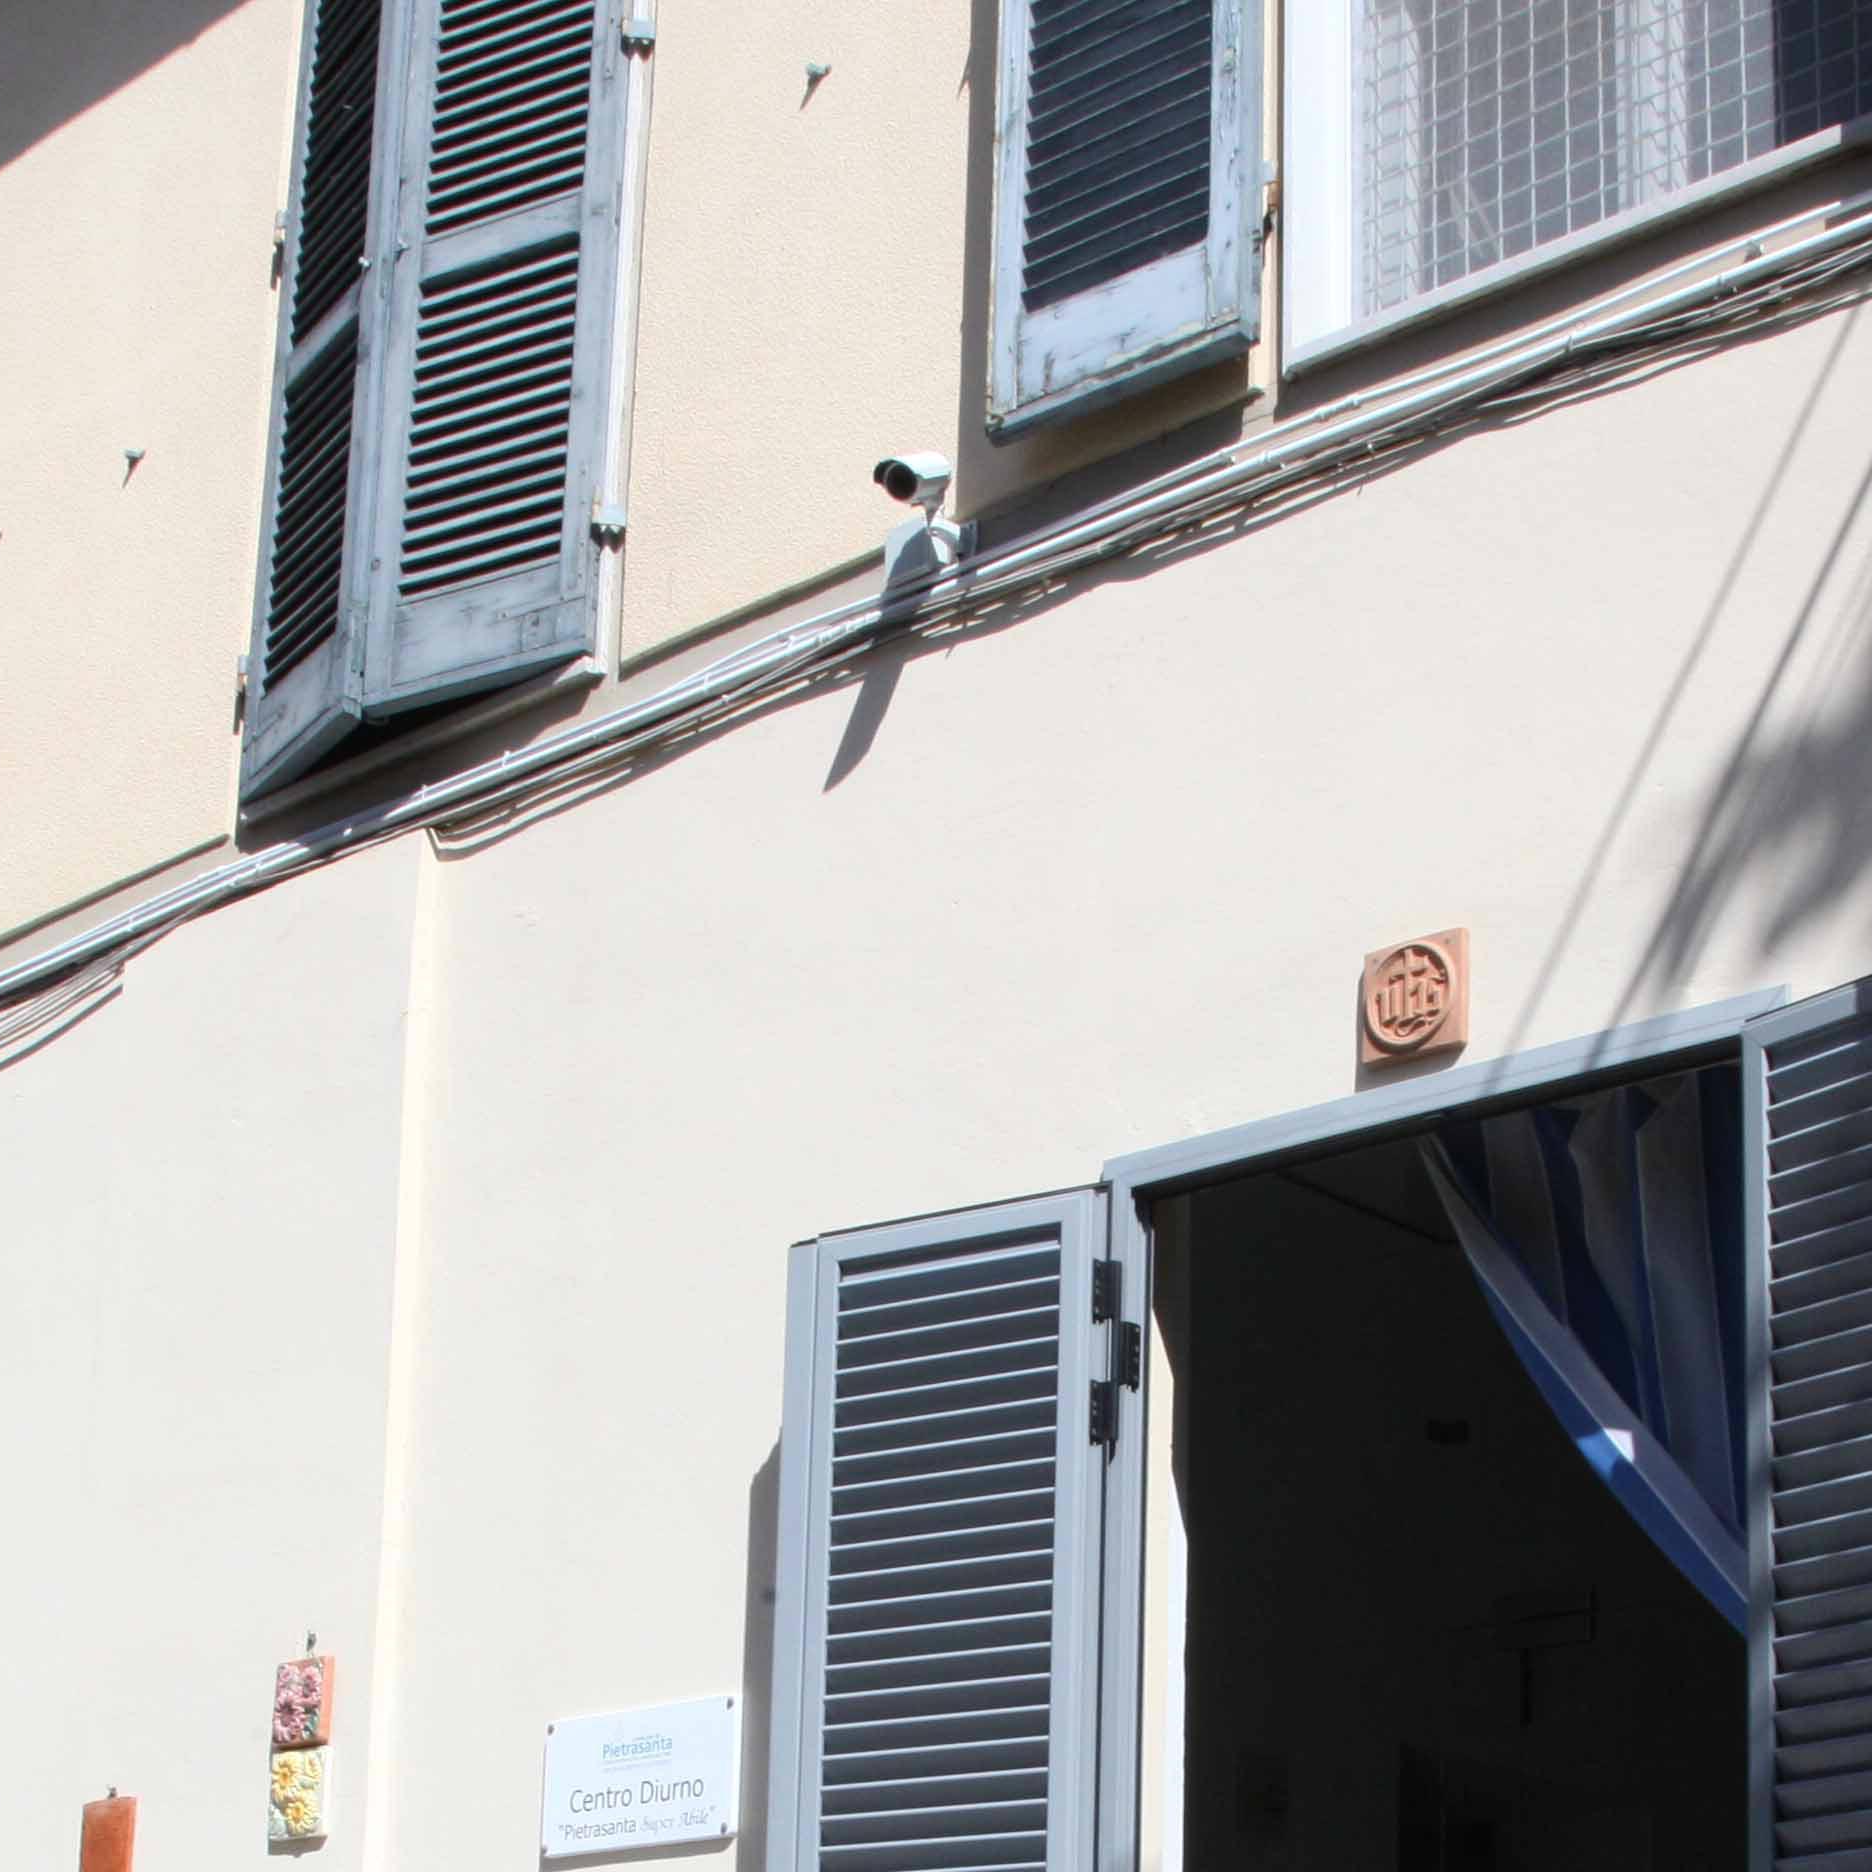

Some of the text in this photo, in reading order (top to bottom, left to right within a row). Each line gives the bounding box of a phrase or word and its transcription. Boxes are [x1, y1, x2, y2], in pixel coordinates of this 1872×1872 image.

[602, 1736, 673, 1760] Pietrasanta
[569, 1778, 704, 1814] Centro Diurno
[558, 1818, 637, 1841] "Pietrasanta
